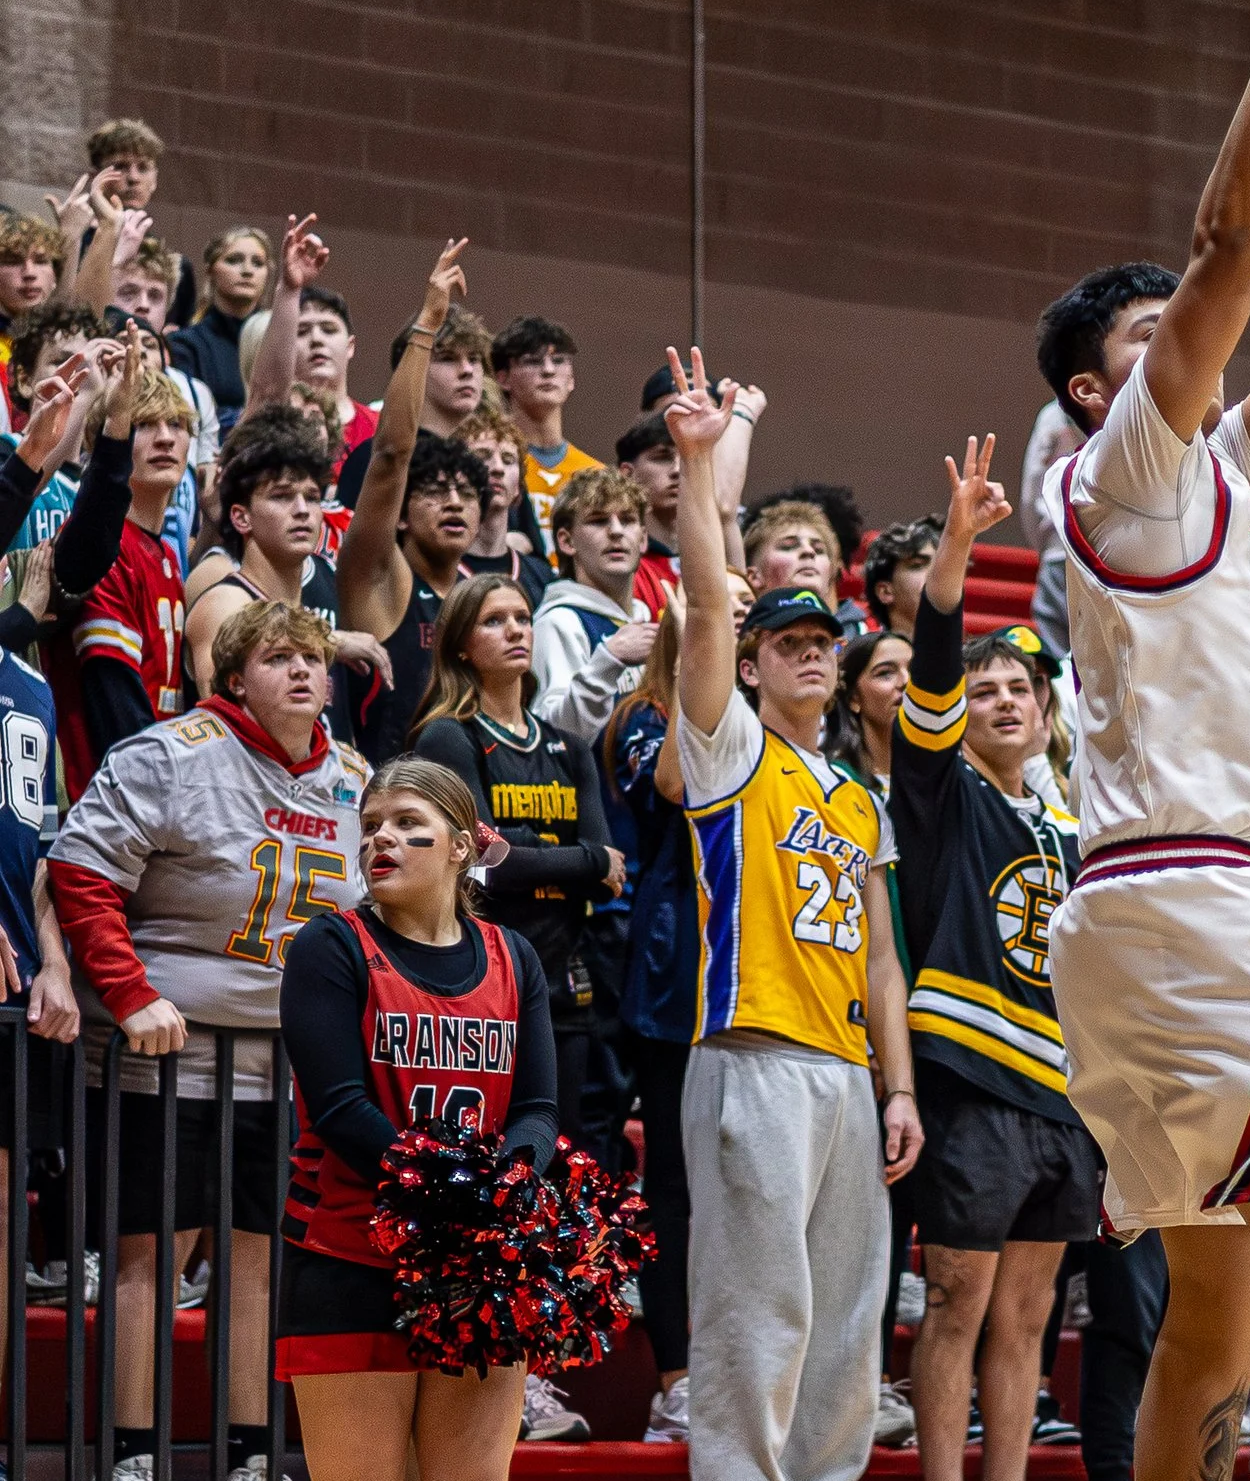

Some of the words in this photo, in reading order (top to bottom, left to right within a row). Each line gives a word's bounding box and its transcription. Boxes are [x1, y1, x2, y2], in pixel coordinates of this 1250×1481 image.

[264, 807, 338, 841] CHIEFS
[224, 838, 348, 964] 15
[791, 860, 865, 954] 23
